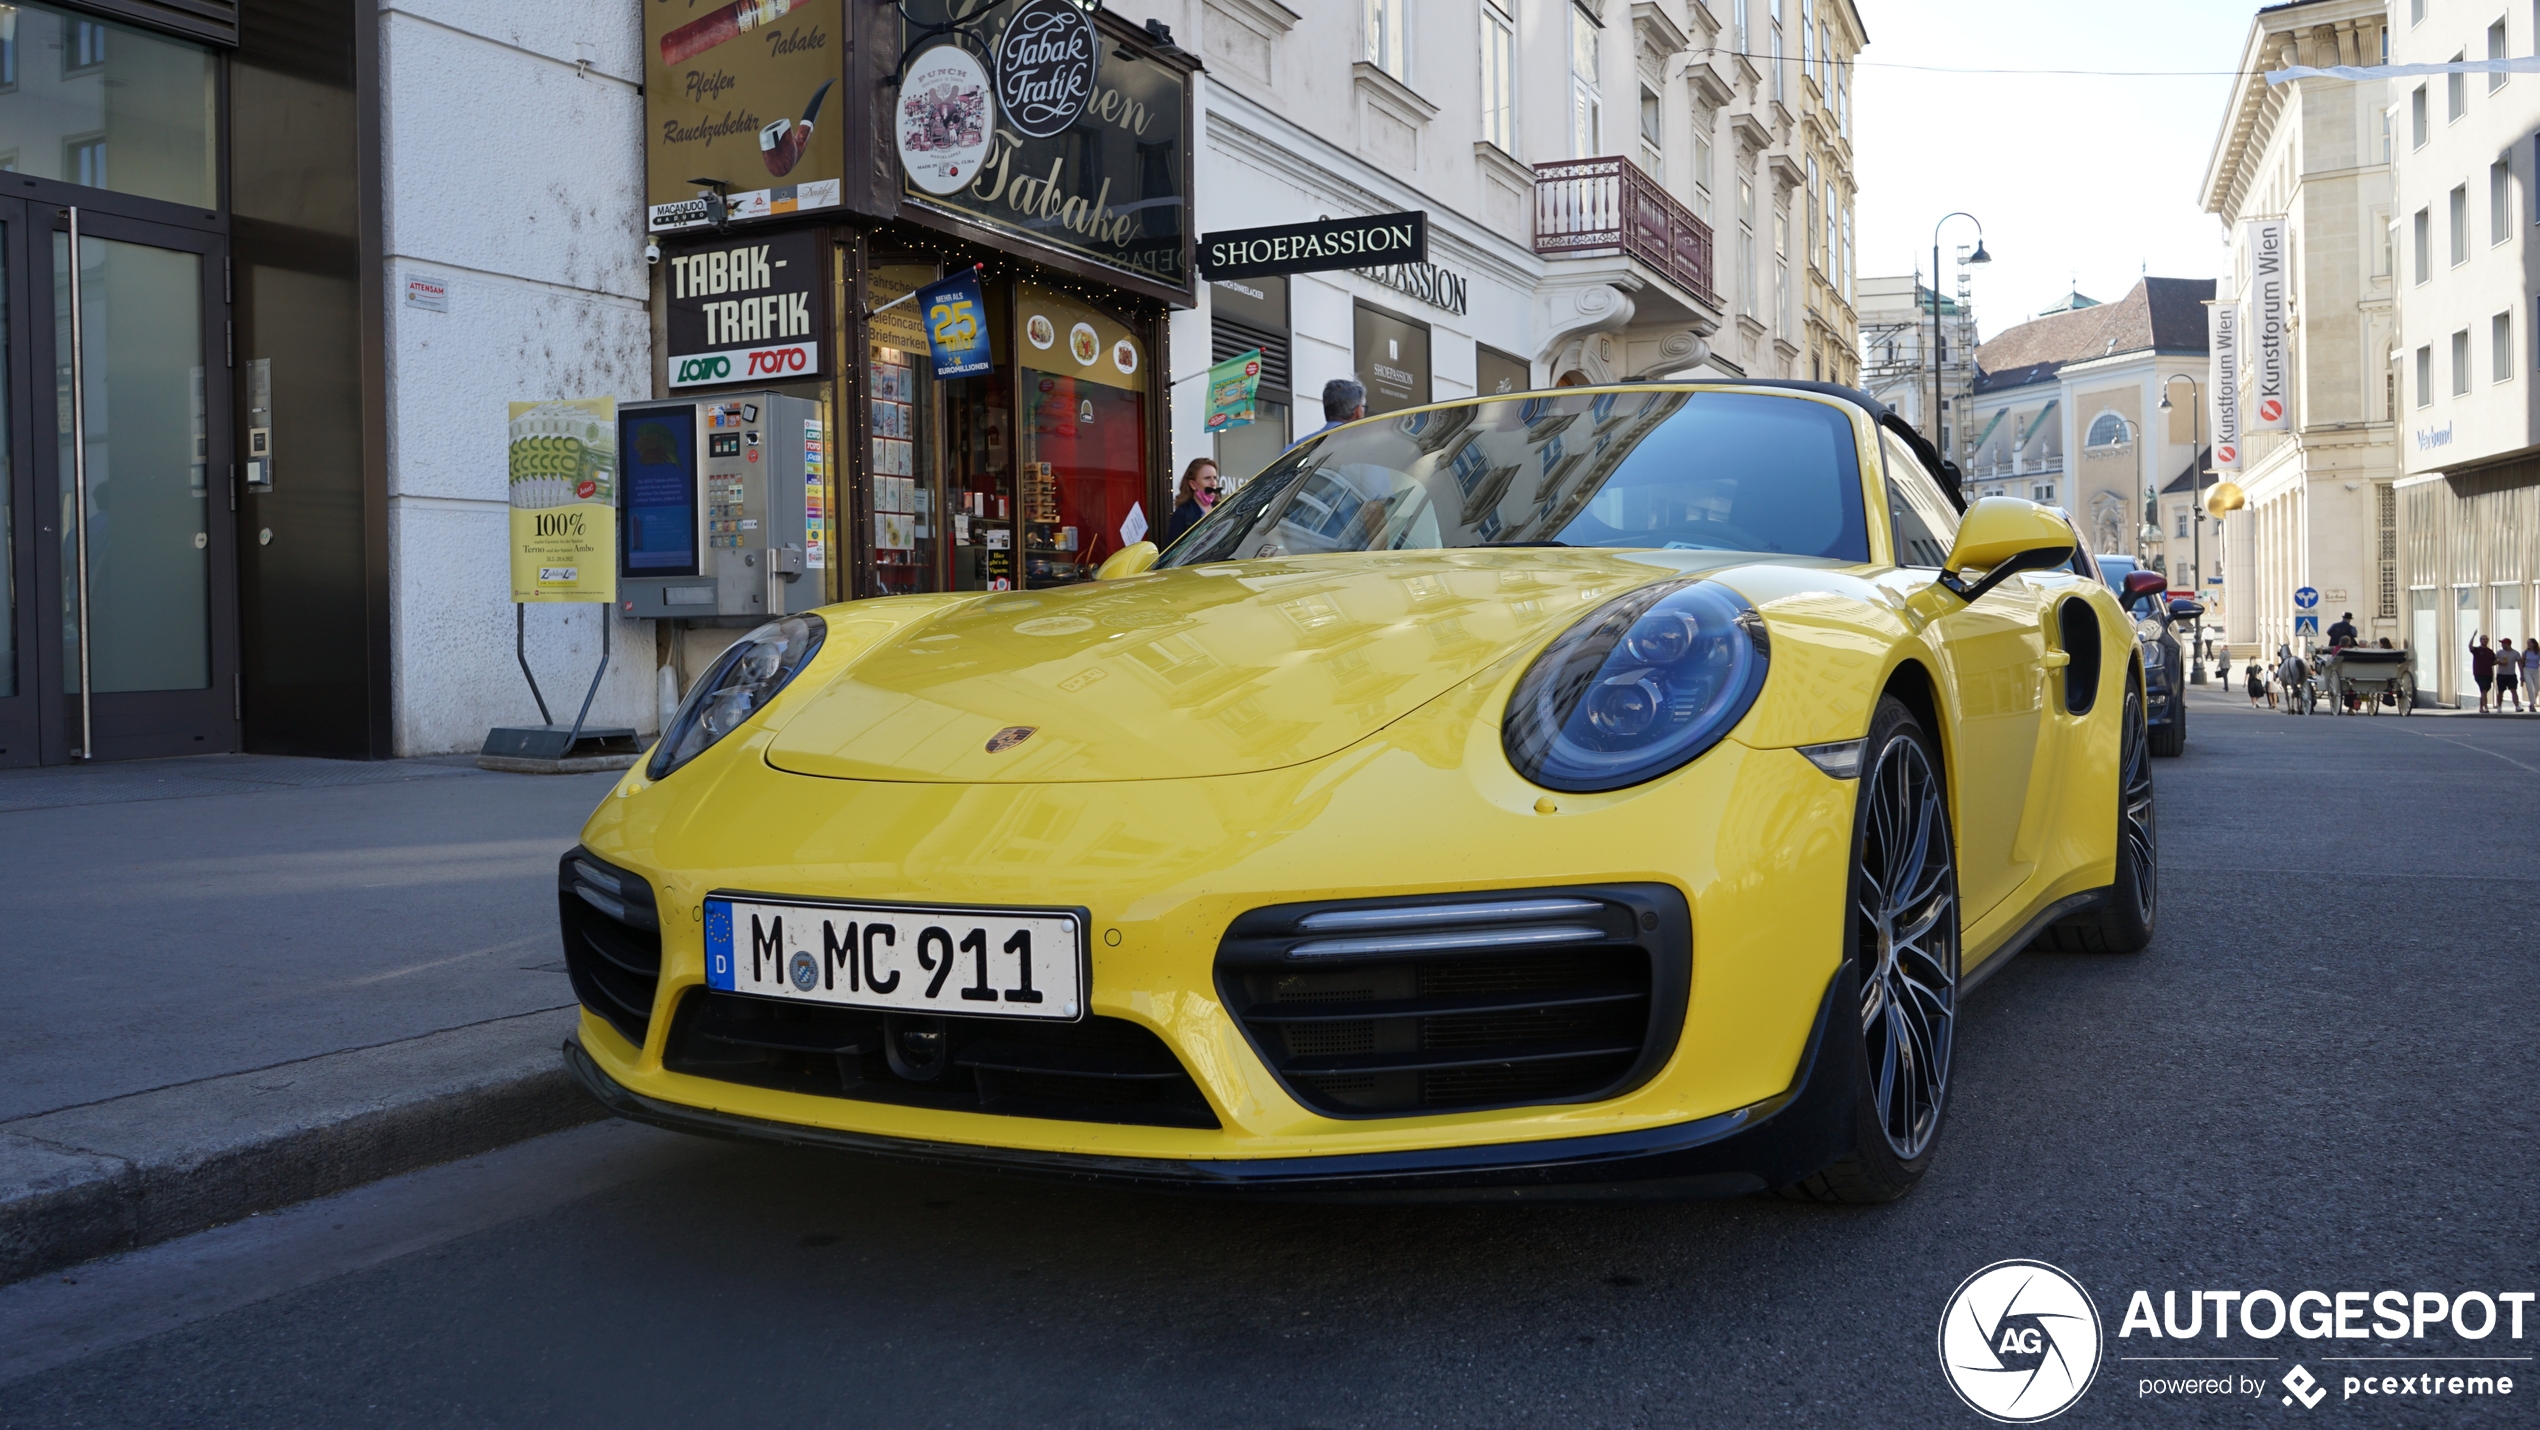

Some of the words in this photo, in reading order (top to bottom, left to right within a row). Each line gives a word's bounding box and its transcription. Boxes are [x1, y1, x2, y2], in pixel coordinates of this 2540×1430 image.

[766, 25, 826, 57] Tabake
[1006, 26, 1088, 72] Tabak
[685, 69, 736, 102] Pfeifen
[917, 68, 968, 84] PUNCH
[1006, 62, 1088, 108] Trafik
[971, 129, 1140, 248] Tabake
[656, 212, 705, 224] MADURO
[1212, 224, 1414, 267] SHOEPASSION
[2259, 227, 2279, 276] Wien
[410, 282, 444, 295] ATTENSAM
[935, 294, 952, 303] MEHR
[953, 292, 964, 300] ALS
[702, 291, 810, 345] TRAFIK
[930, 300, 978, 345] 25
[2216, 310, 2233, 350] Wien
[869, 327, 927, 351] Briefmarken
[2262, 281, 2281, 396] Kunstforum
[677, 356, 731, 383] LOTTO
[748, 347, 807, 376] TOTO
[938, 362, 989, 375] EUROMILLIONEN
[1374, 363, 1413, 385] SHOEPASSION
[2218, 355, 2235, 443] Kunstforum
[2417, 420, 2452, 451] Verbund
[579, 484, 594, 495] Jetzt!
[534, 512, 586, 536] 100%
[523, 545, 544, 553] Terno
[573, 544, 594, 552] Ambo
[716, 954, 726, 974] D
[752, 913, 784, 984] M
[823, 920, 900, 995] MC
[917, 926, 1044, 1004] 911
